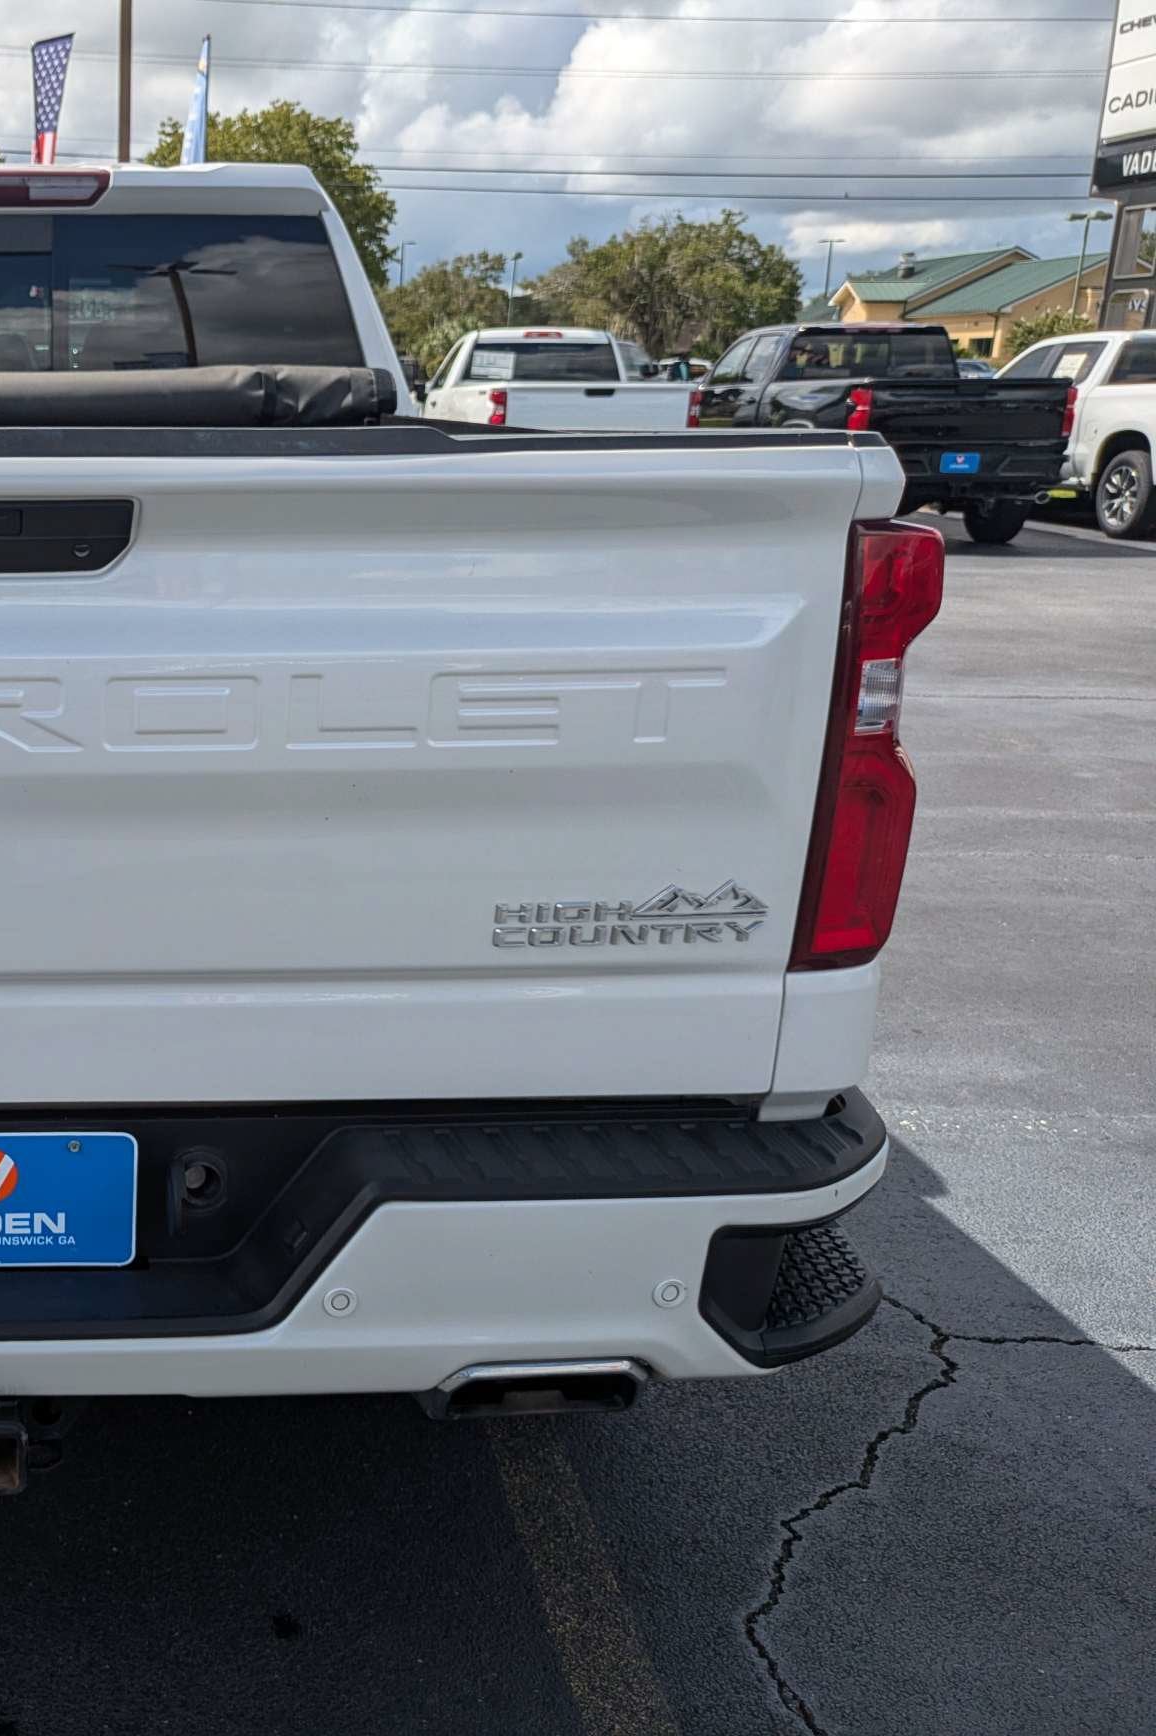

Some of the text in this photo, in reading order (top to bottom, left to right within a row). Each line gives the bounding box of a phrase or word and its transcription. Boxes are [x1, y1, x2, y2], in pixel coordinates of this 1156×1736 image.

[495, 900, 634, 924] HIGH
[492, 920, 765, 948] COUNTRY
[58, 1235, 77, 1246] GA
